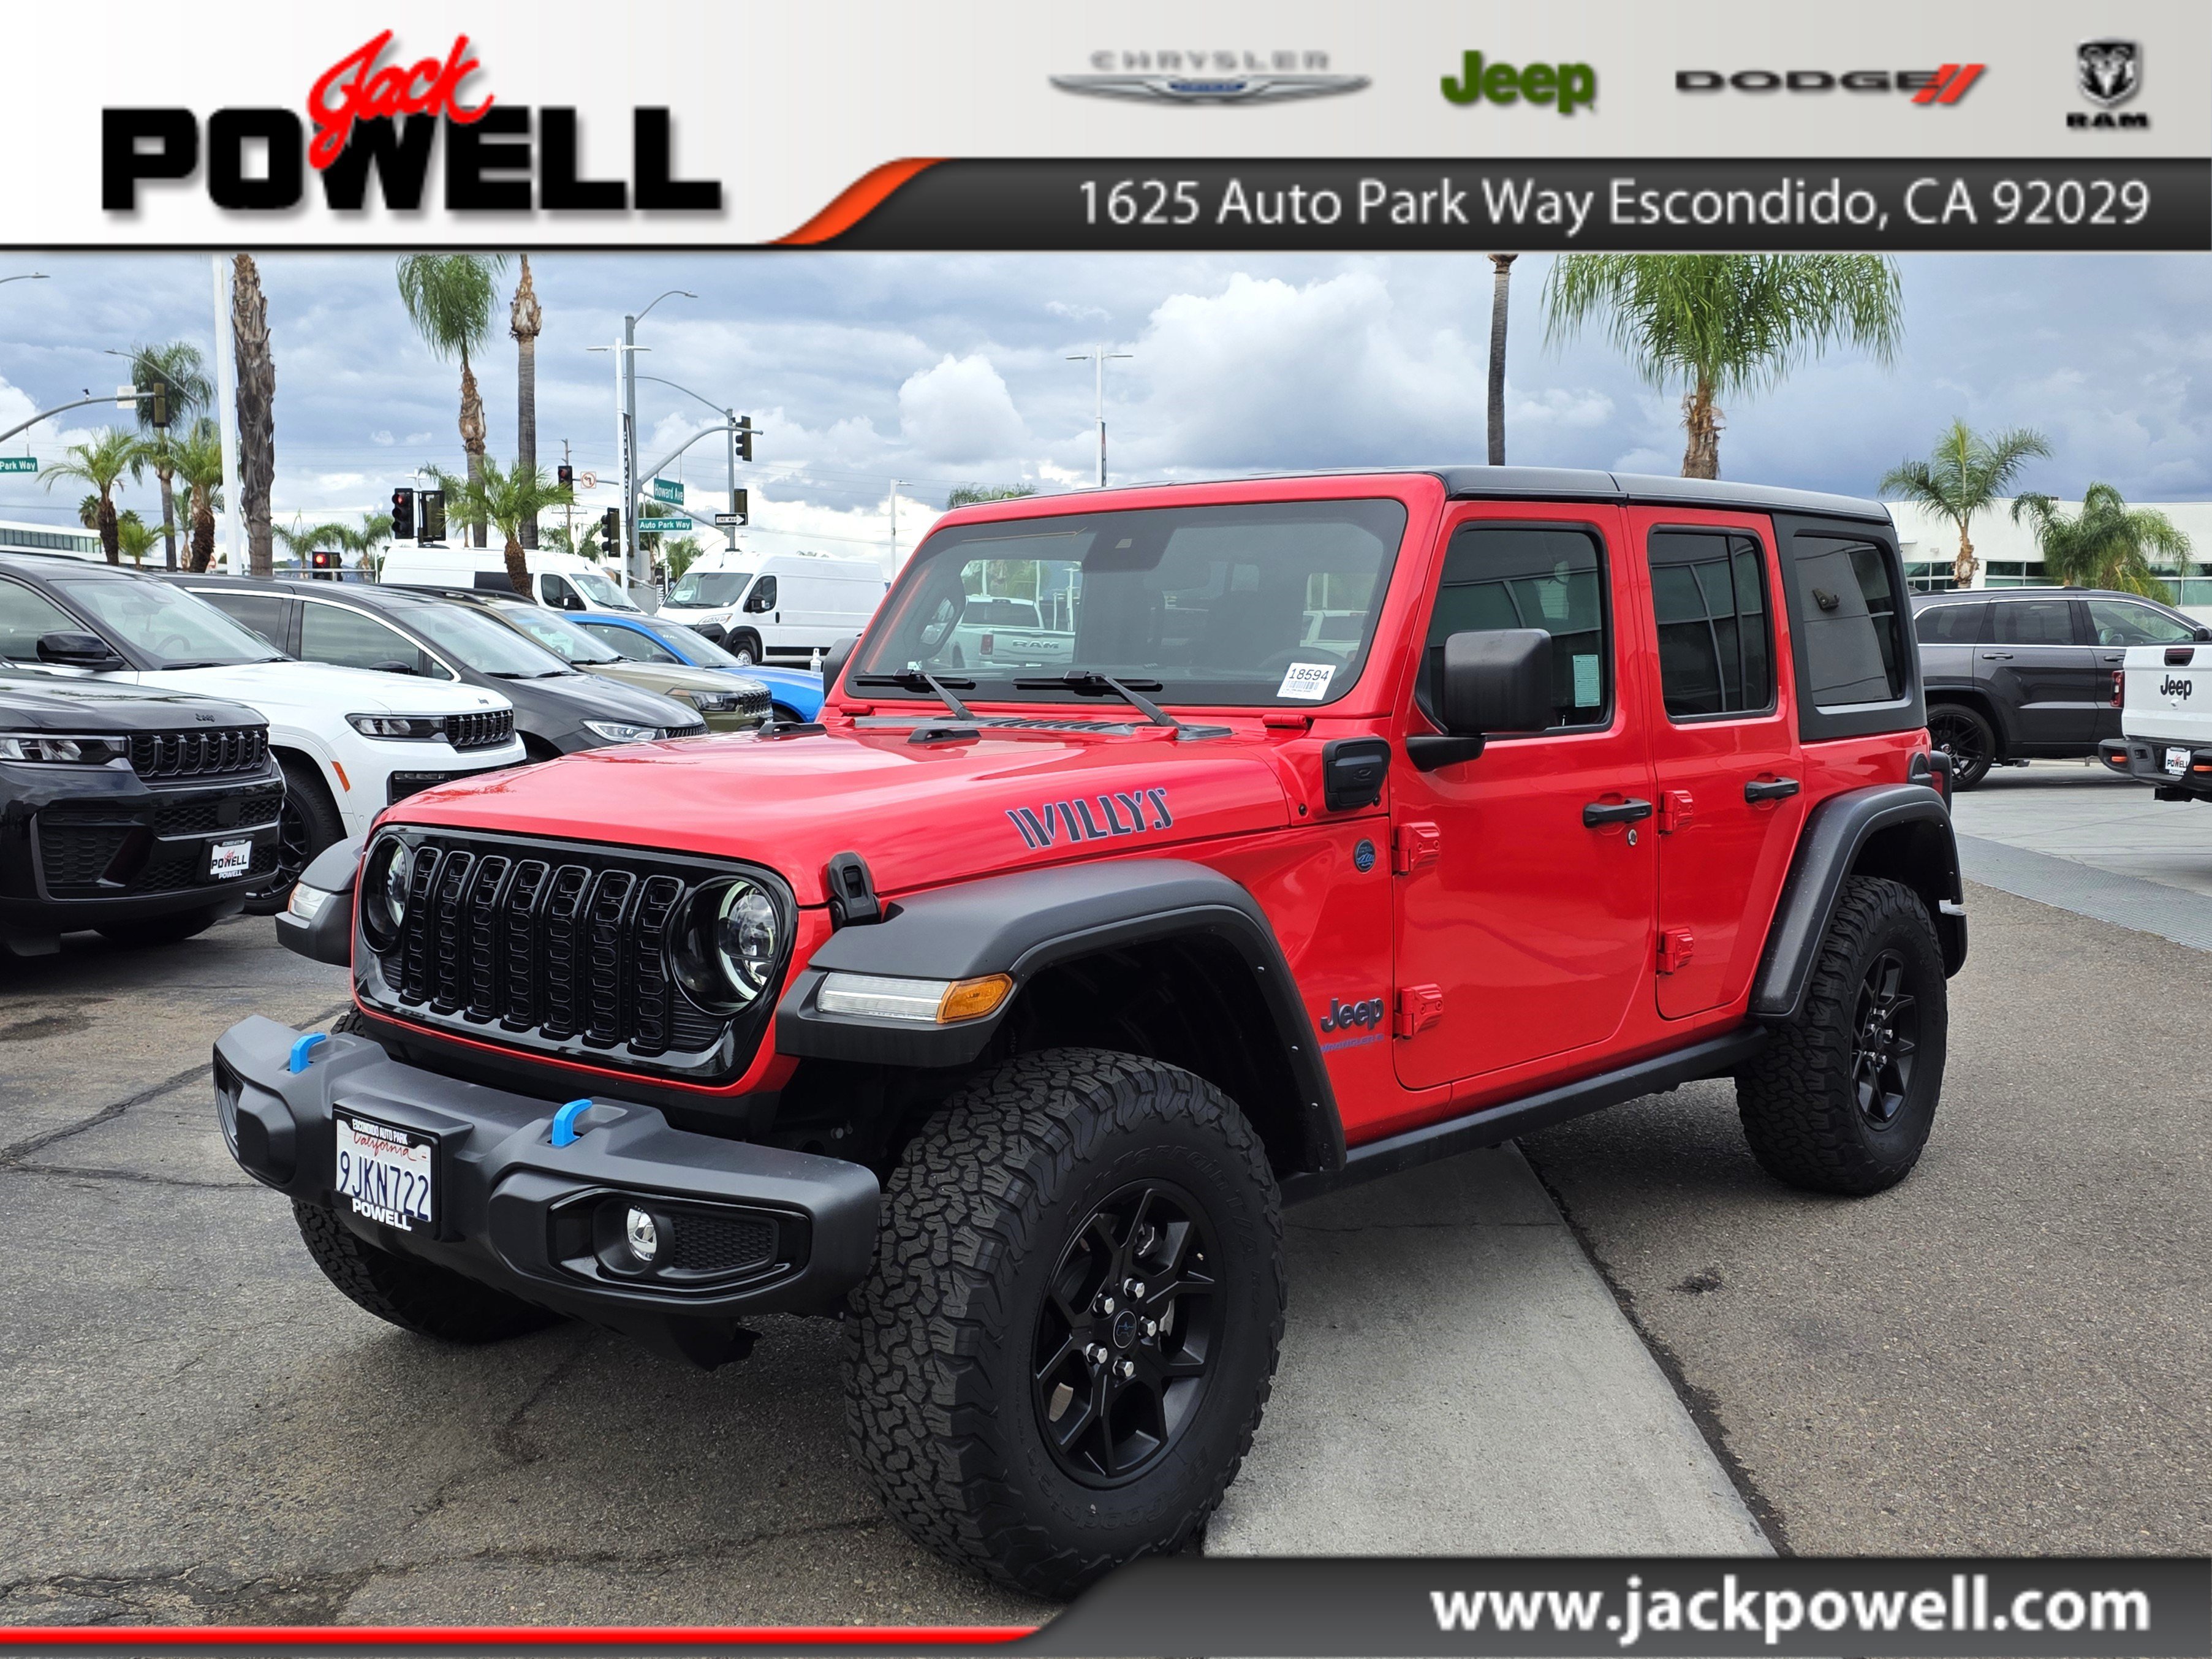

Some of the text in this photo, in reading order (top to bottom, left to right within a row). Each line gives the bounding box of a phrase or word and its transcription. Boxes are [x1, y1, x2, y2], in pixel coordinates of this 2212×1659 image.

[0, 460, 36, 471] Park Way
[654, 484, 683, 501] Howard Ave
[675, 521, 691, 530] Way
[1012, 640, 1059, 649] RAM
[1289, 668, 1330, 681] 18594
[2160, 674, 2192, 700] Jeep
[1005, 788, 1173, 849] WILLYS
[211, 854, 247, 870] POWELL
[1320, 997, 1385, 1034] Jeep
[352, 1118, 409, 1145] ESCONDIDO AUTO PARK
[354, 1131, 417, 1161] California
[340, 1150, 430, 1221] 9JKN722
[352, 1198, 412, 1231] POWELL
